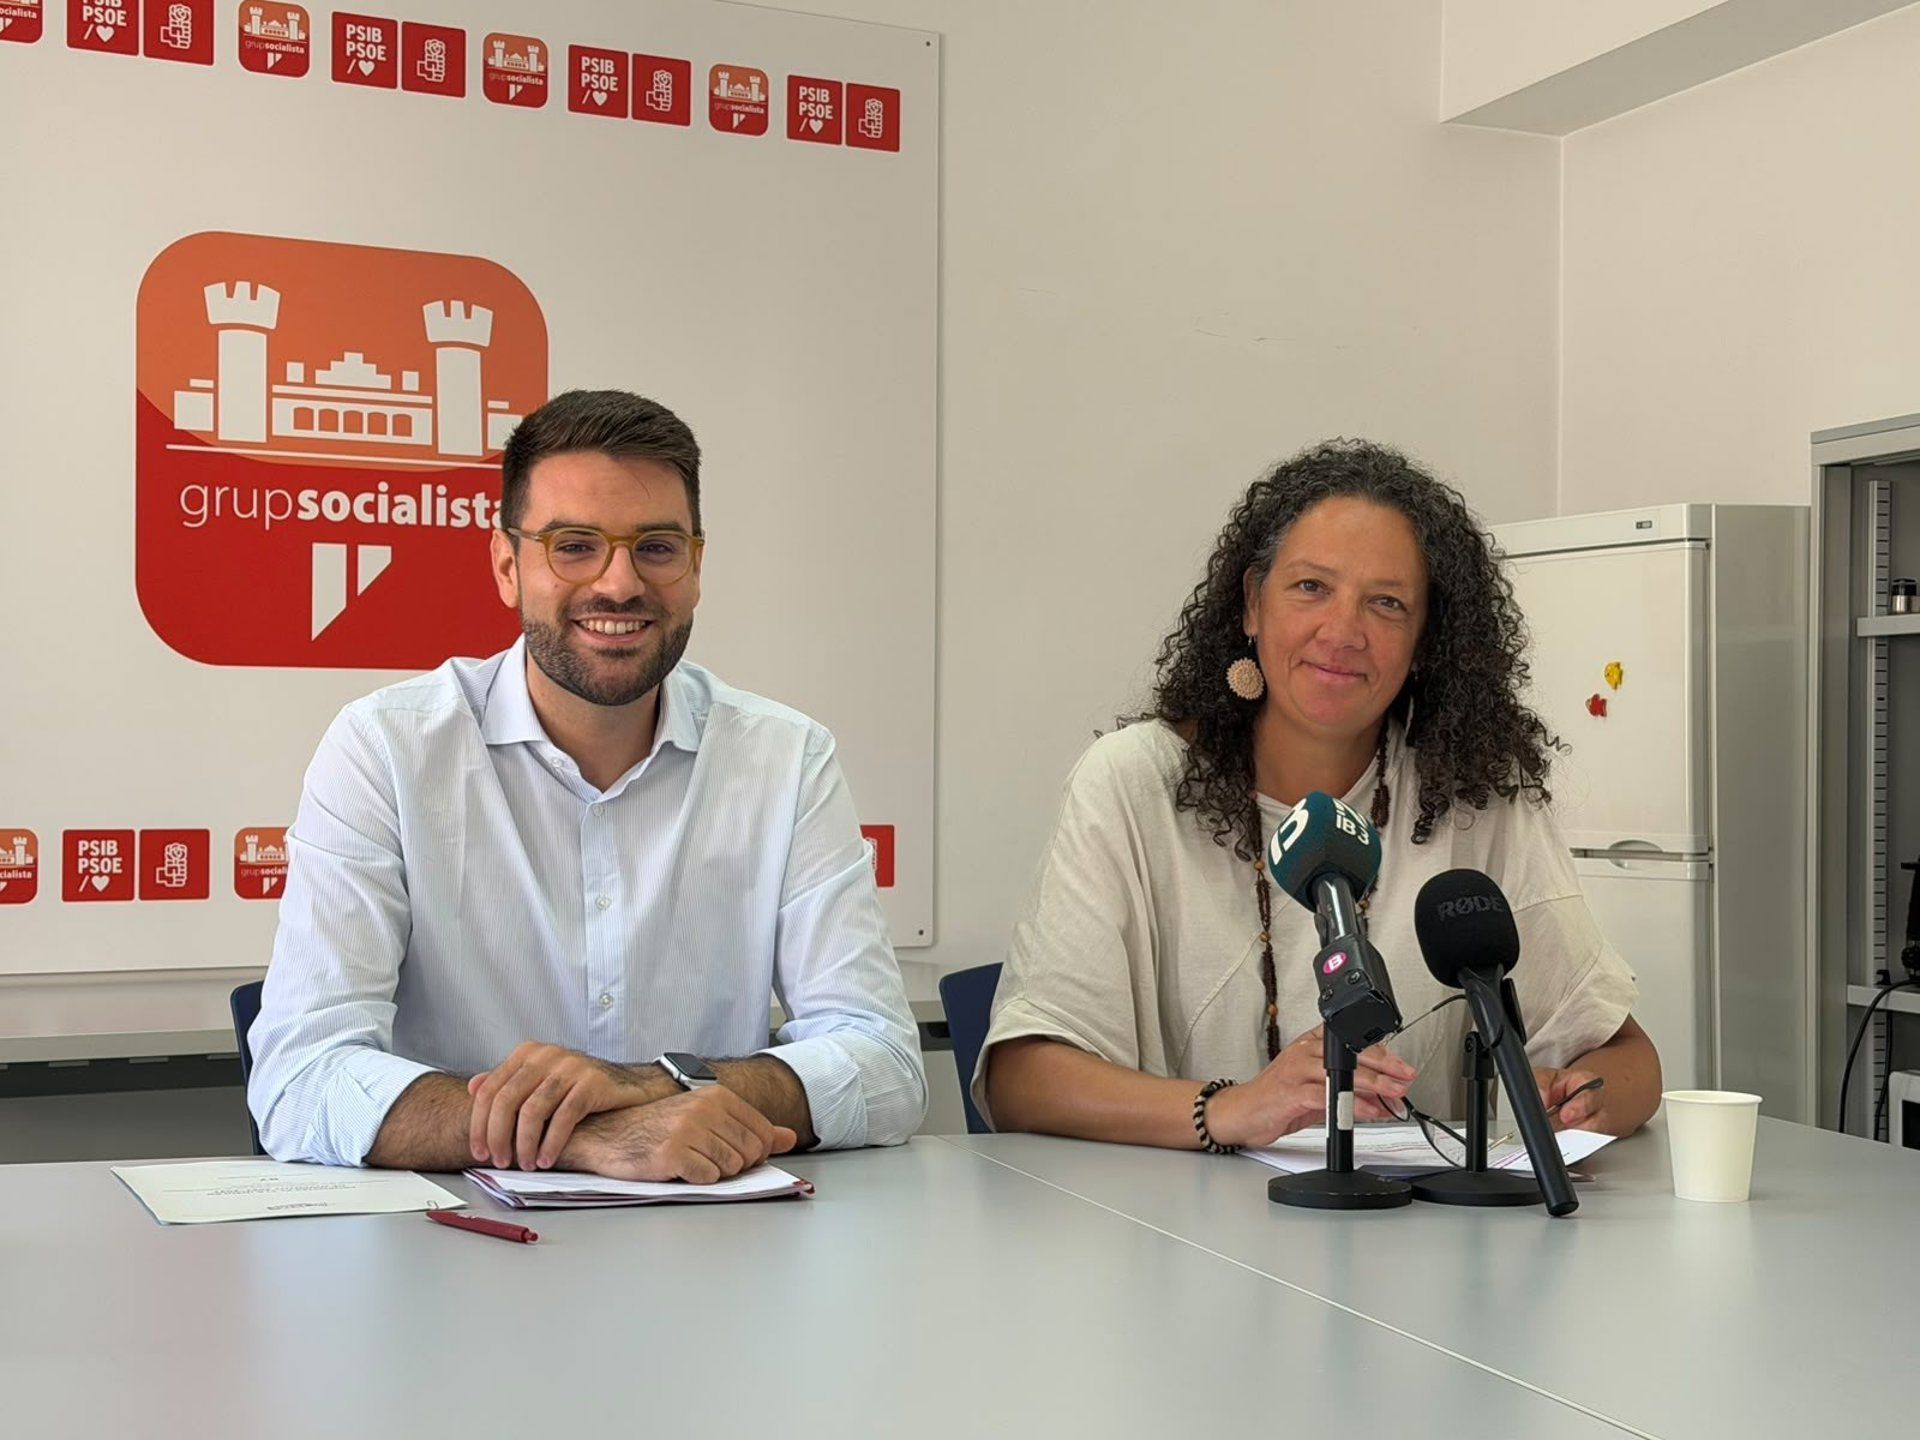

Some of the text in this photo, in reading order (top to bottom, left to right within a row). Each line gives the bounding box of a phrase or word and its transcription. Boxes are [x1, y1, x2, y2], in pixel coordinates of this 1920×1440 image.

[82, 5, 127, 27] PSOE
[345, 23, 383, 43] PSIB
[345, 41, 387, 61] PSOE
[581, 56, 615, 74] PSIB
[581, 73, 618, 92] PSOE
[799, 85, 830, 103] PSIB
[799, 101, 834, 119] PSOE
[1336, 813, 1370, 845] IB3
[78, 839, 119, 857] PSIB
[78, 857, 123, 874] PSOE
